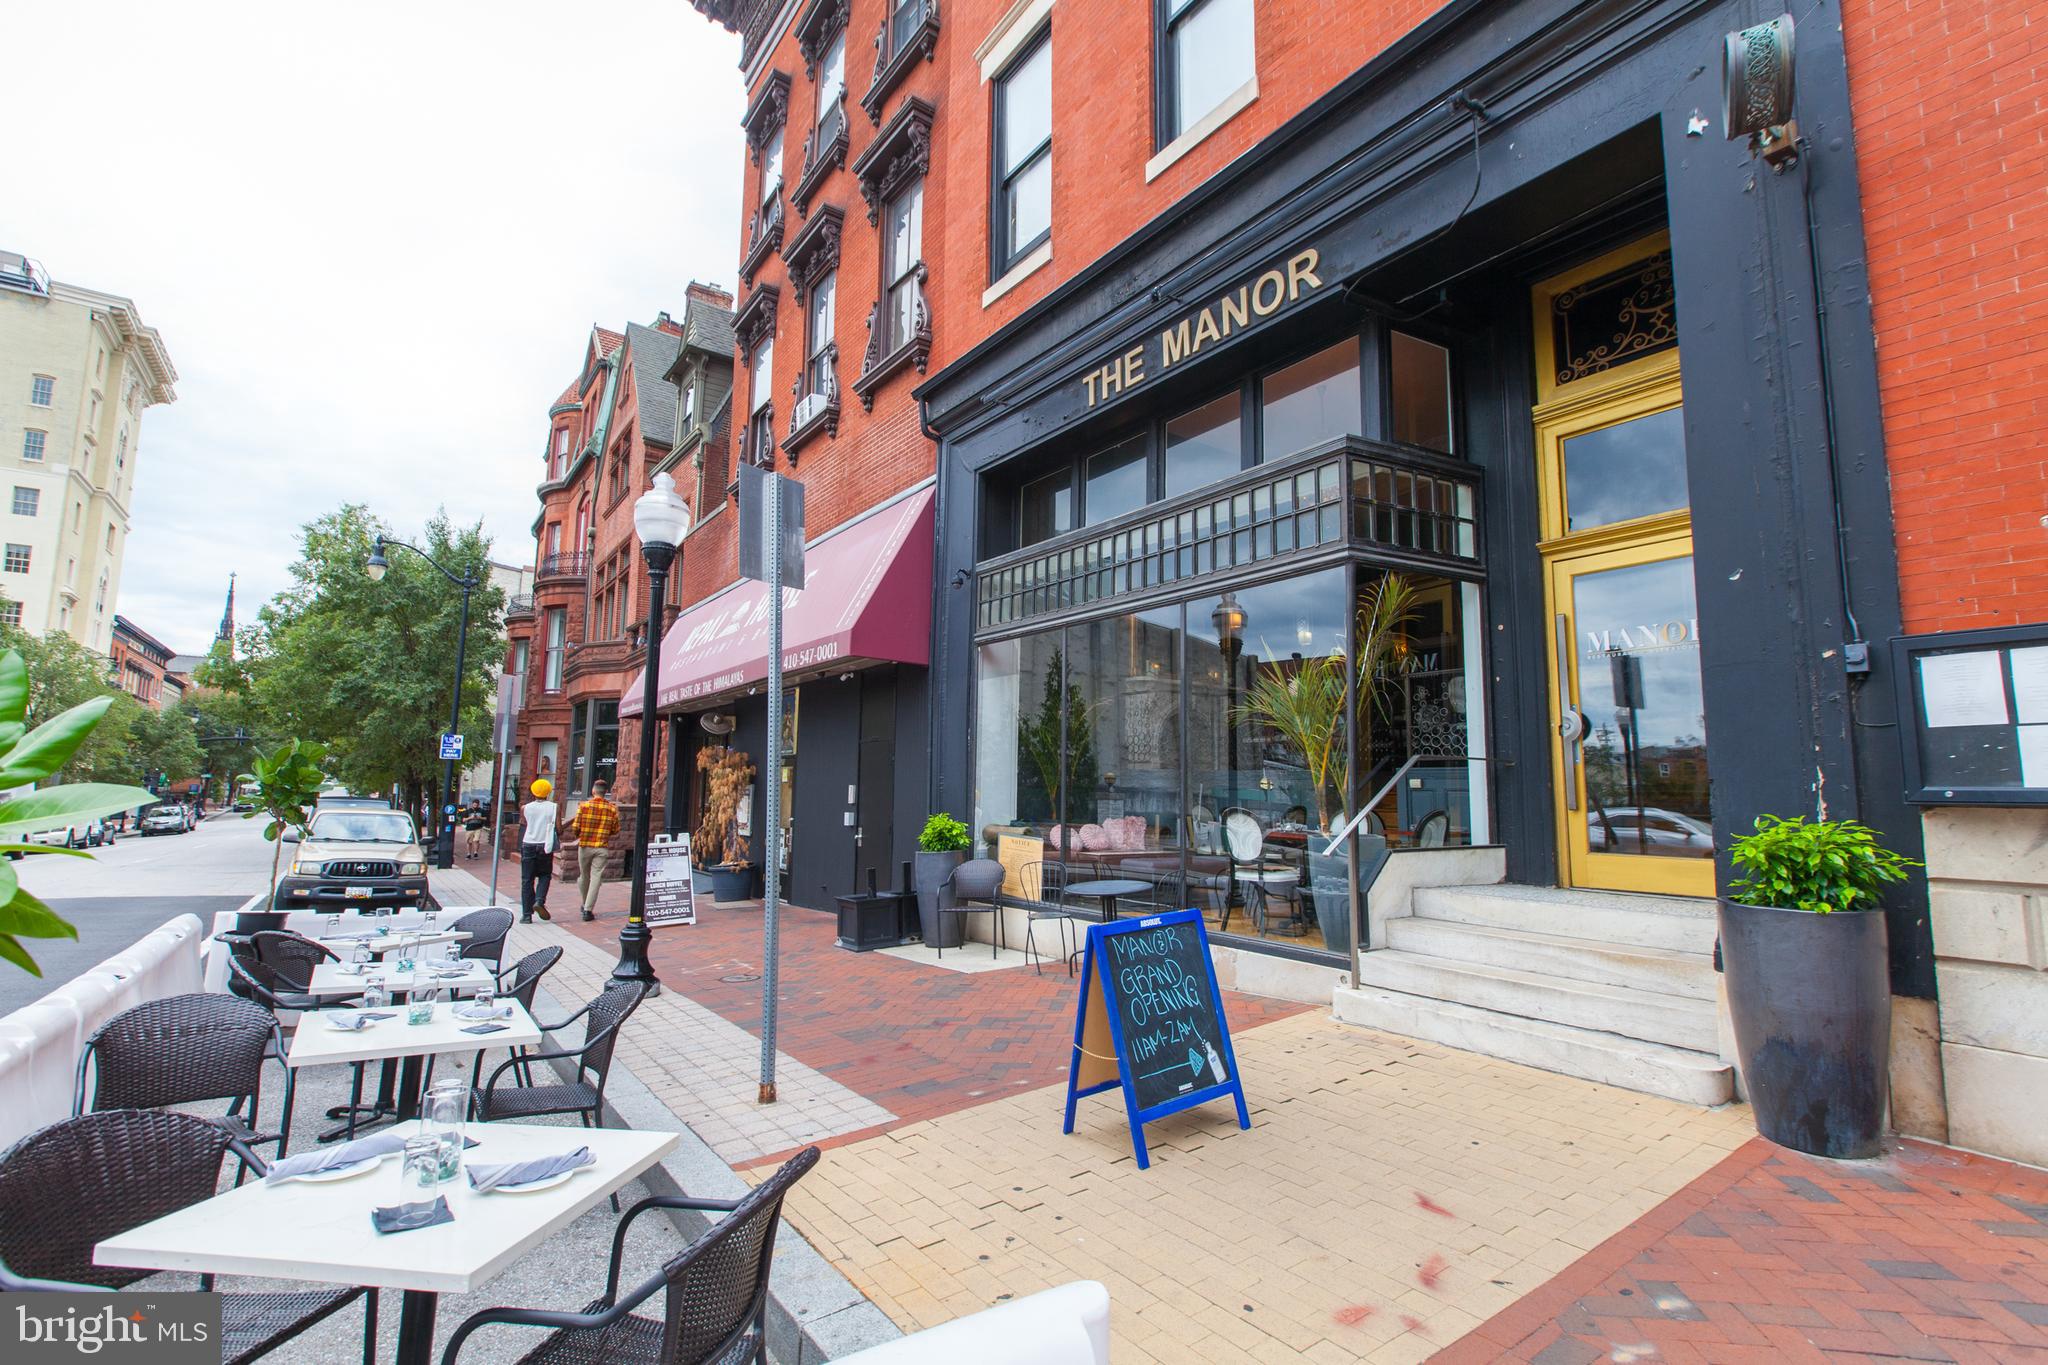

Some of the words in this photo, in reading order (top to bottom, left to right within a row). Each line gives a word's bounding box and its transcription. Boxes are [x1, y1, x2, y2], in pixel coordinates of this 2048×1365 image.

[1082, 344, 1145, 407] THE
[1161, 248, 1323, 368] MANOR
[783, 641, 838, 670] 410-547-0001
[680, 685, 693, 700] TASTE
[694, 682, 701, 695] OF
[703, 680, 712, 693] THE
[714, 670, 744, 690] HIMALAYAS
[646, 906, 691, 917] 410-547-0001
[1111, 927, 1184, 965] MANOR
[1120, 958, 1183, 995] GRAND
[1131, 975, 1204, 1026] OPENING
